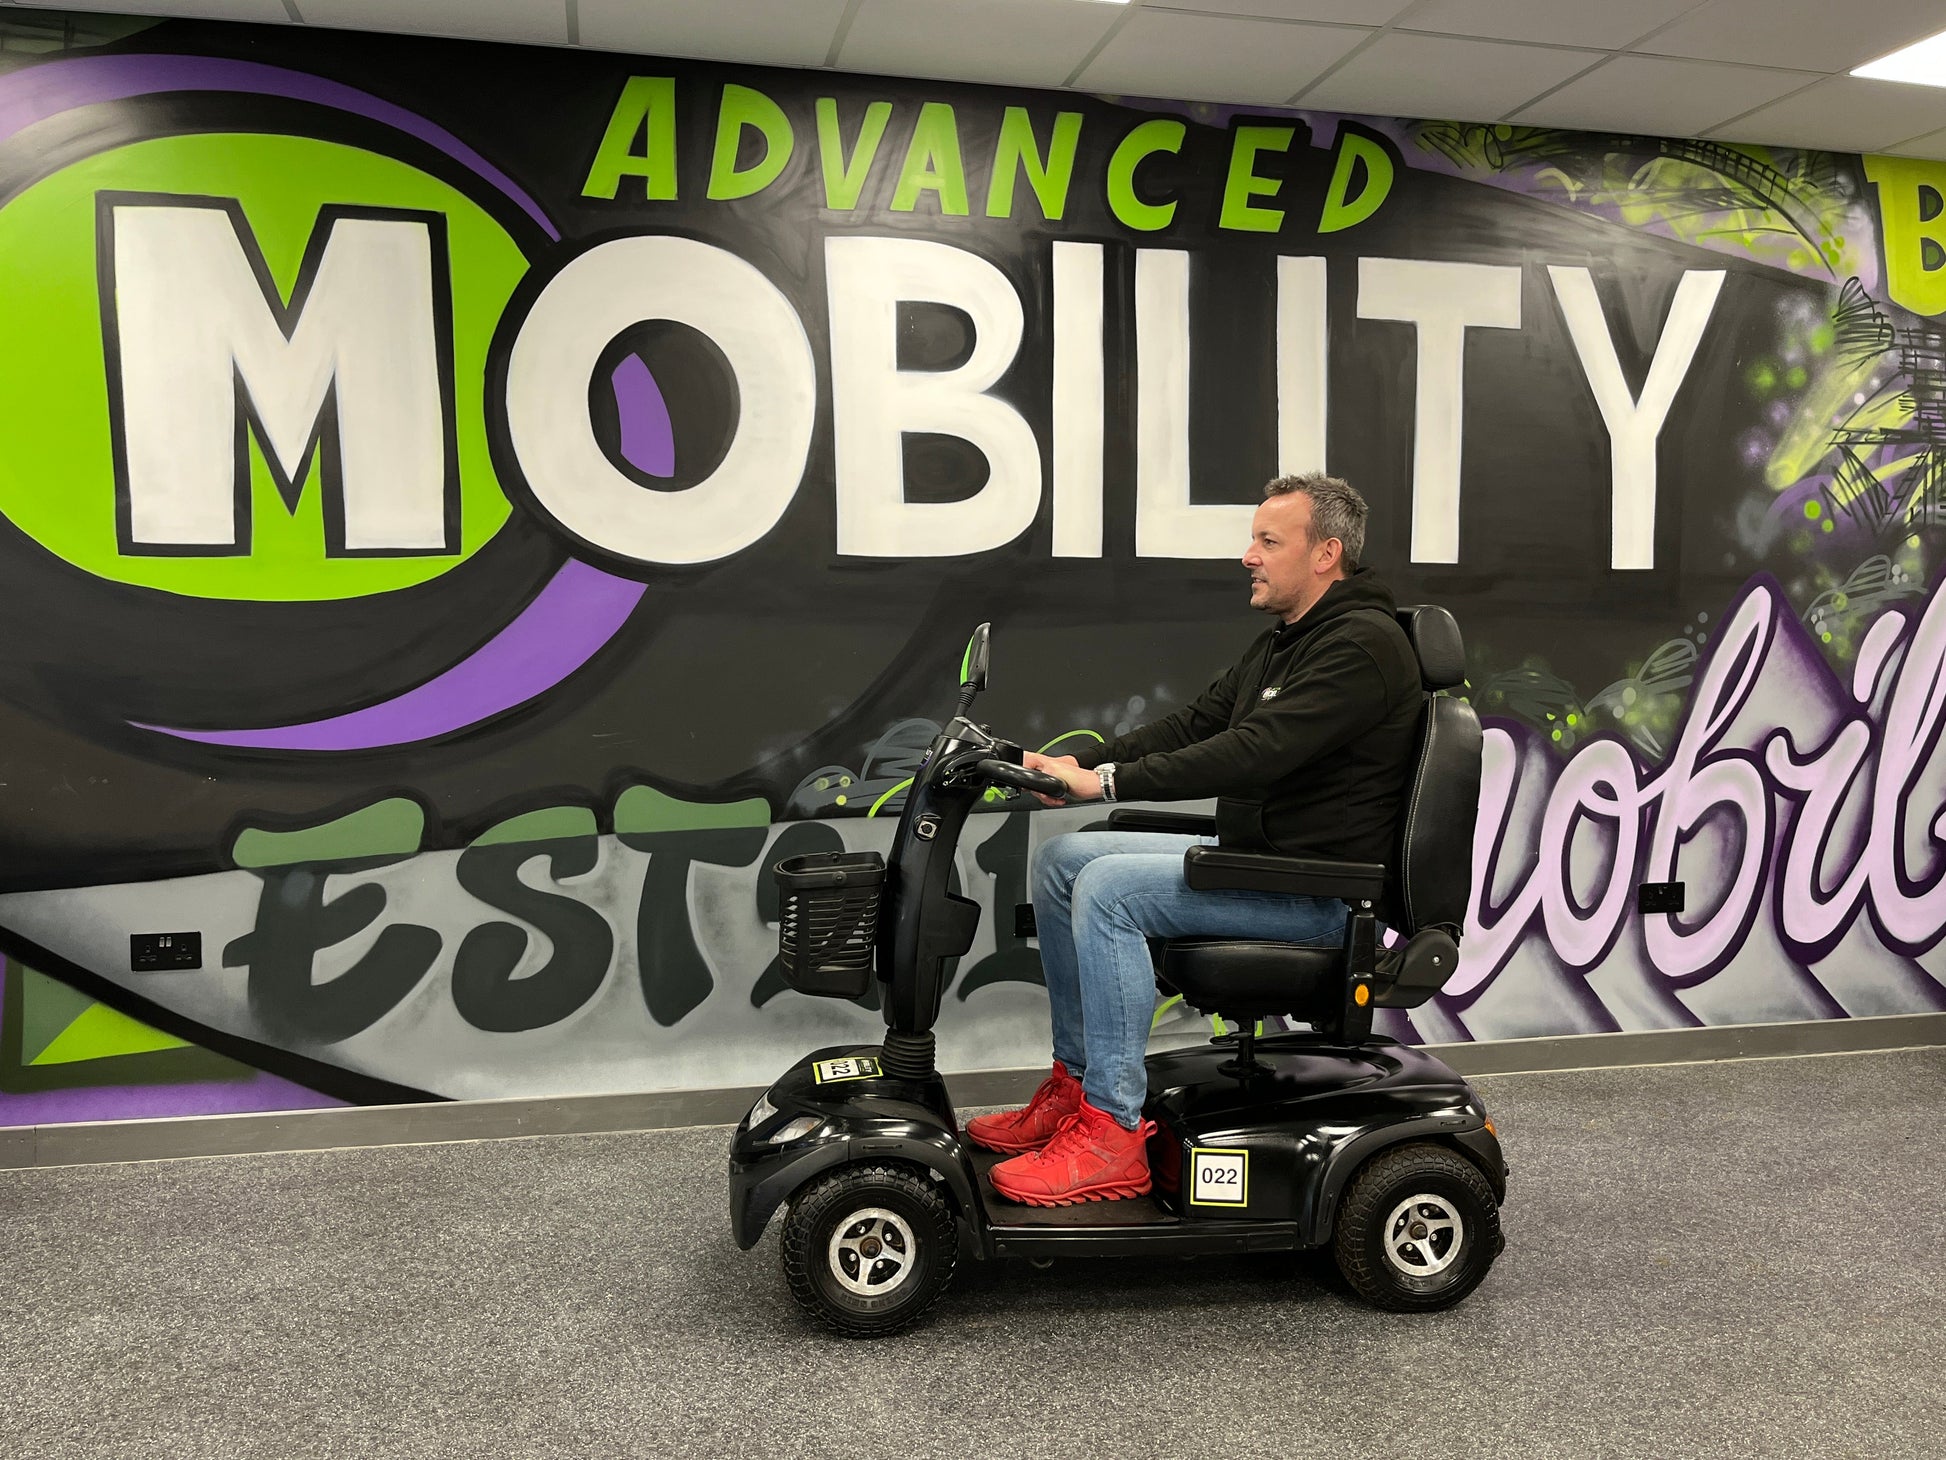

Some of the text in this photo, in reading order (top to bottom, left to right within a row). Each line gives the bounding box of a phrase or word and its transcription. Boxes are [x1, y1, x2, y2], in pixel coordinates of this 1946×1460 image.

[581, 75, 1395, 234] ADVANCED
[98, 194, 1728, 571] MOBILITY
[222, 785, 771, 1046] EST
[1202, 1167, 1238, 1185] 022
